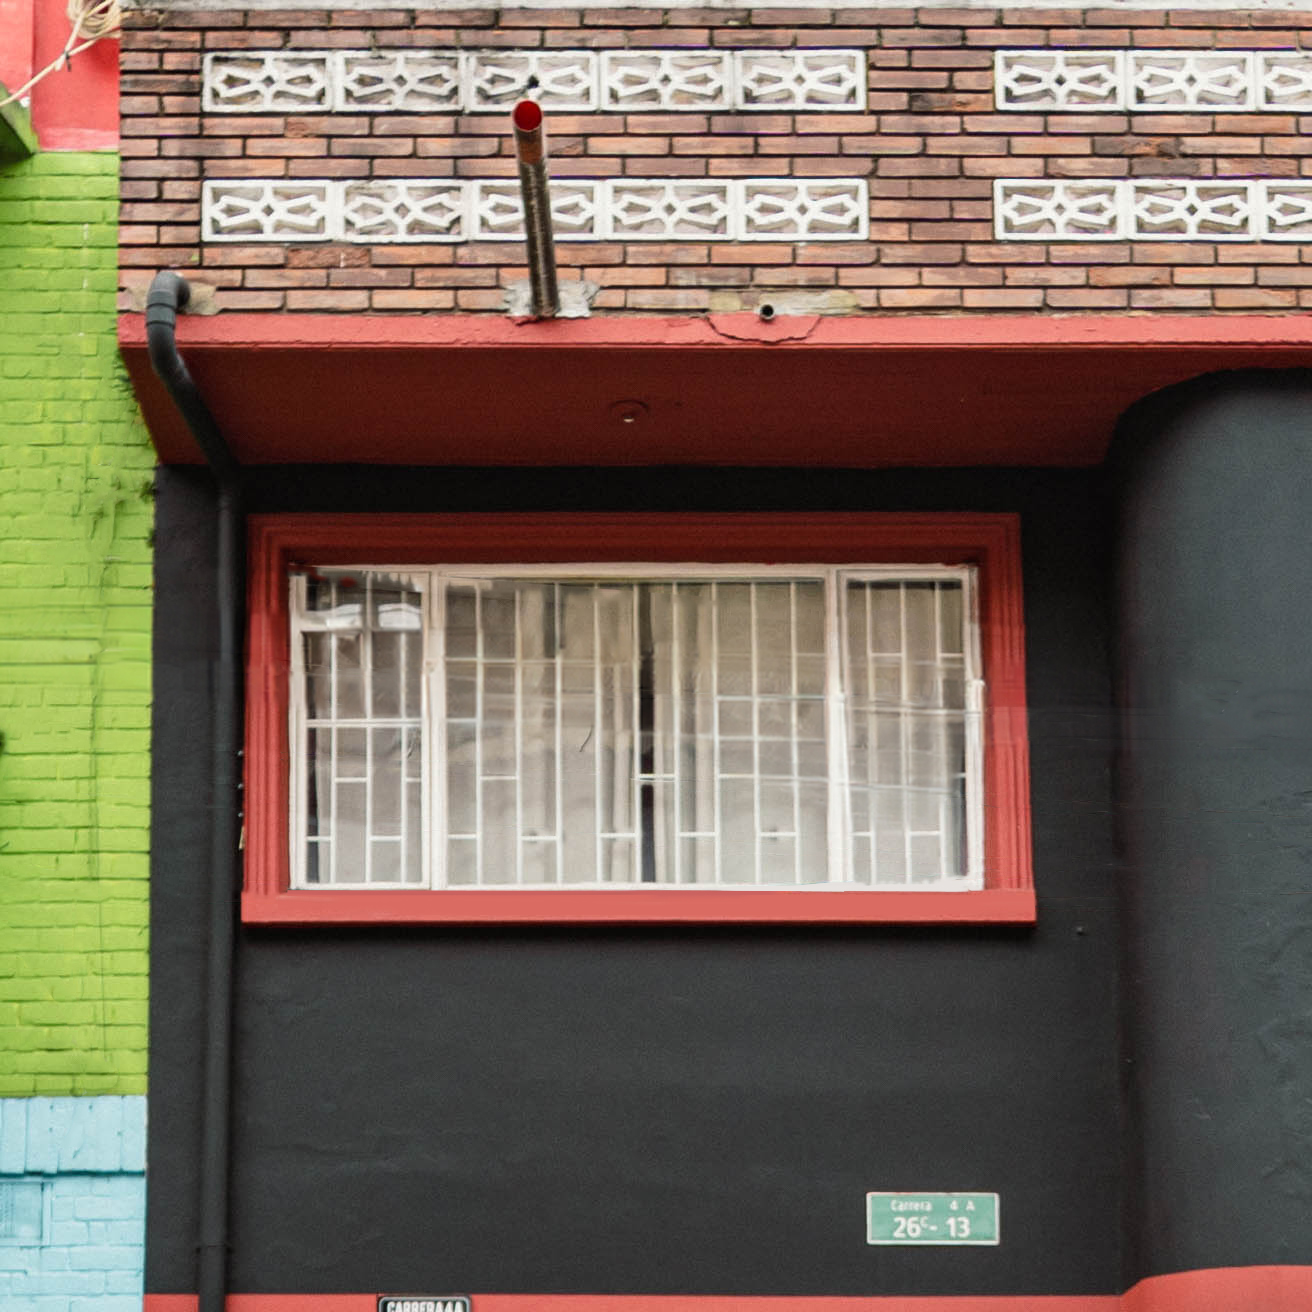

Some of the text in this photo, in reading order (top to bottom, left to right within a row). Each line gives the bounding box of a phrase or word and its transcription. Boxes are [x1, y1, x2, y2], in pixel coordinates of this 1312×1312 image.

[890, 1199, 976, 1212] Carrera 4 A
[945, 1216, 971, 1239] 13
